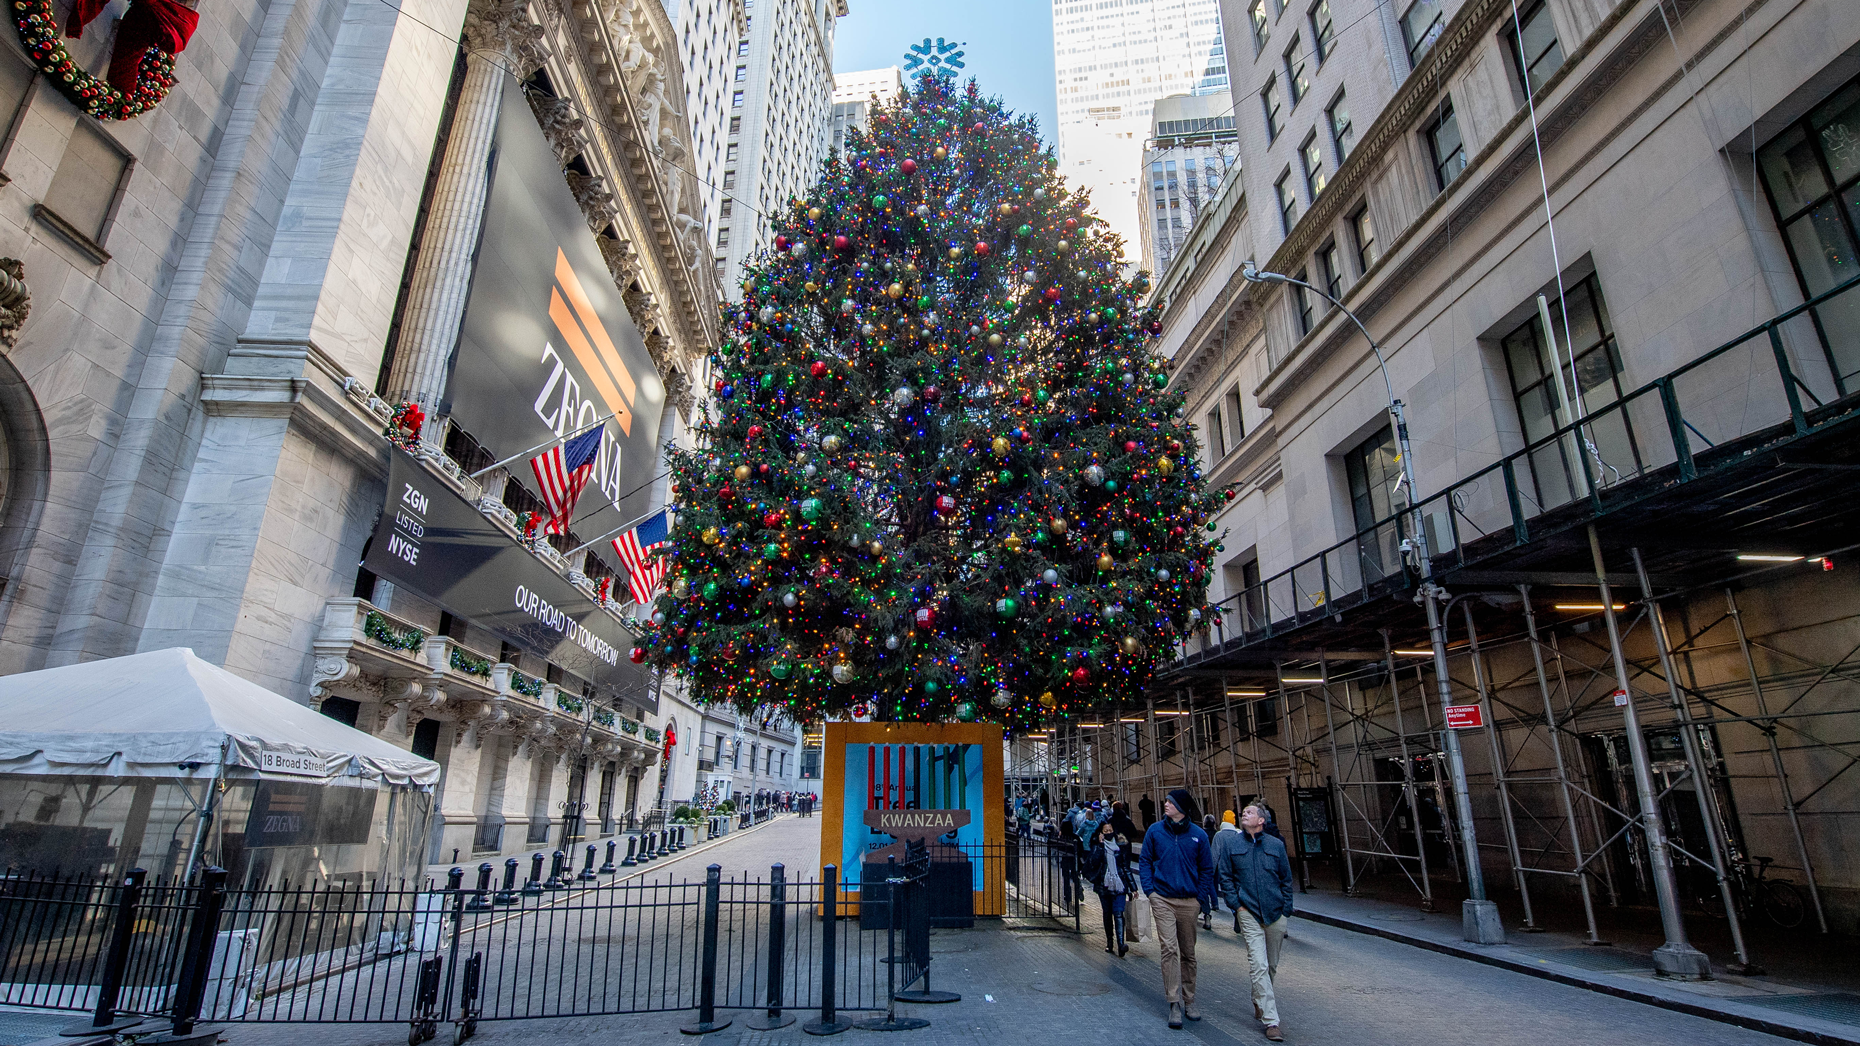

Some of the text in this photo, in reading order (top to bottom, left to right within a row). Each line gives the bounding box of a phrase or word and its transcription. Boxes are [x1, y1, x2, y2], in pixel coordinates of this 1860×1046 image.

[595, 121, 612, 169] YORK
[402, 482, 429, 515] ZGN
[395, 511, 424, 538] LISTED
[387, 534, 419, 566] NYSE
[515, 585, 619, 667] OUR ROAD TO TOMORROW
[263, 754, 326, 772] 18 Broad Street
[262, 815, 300, 833] ZEGNA
[881, 813, 954, 827] KWANZAA
